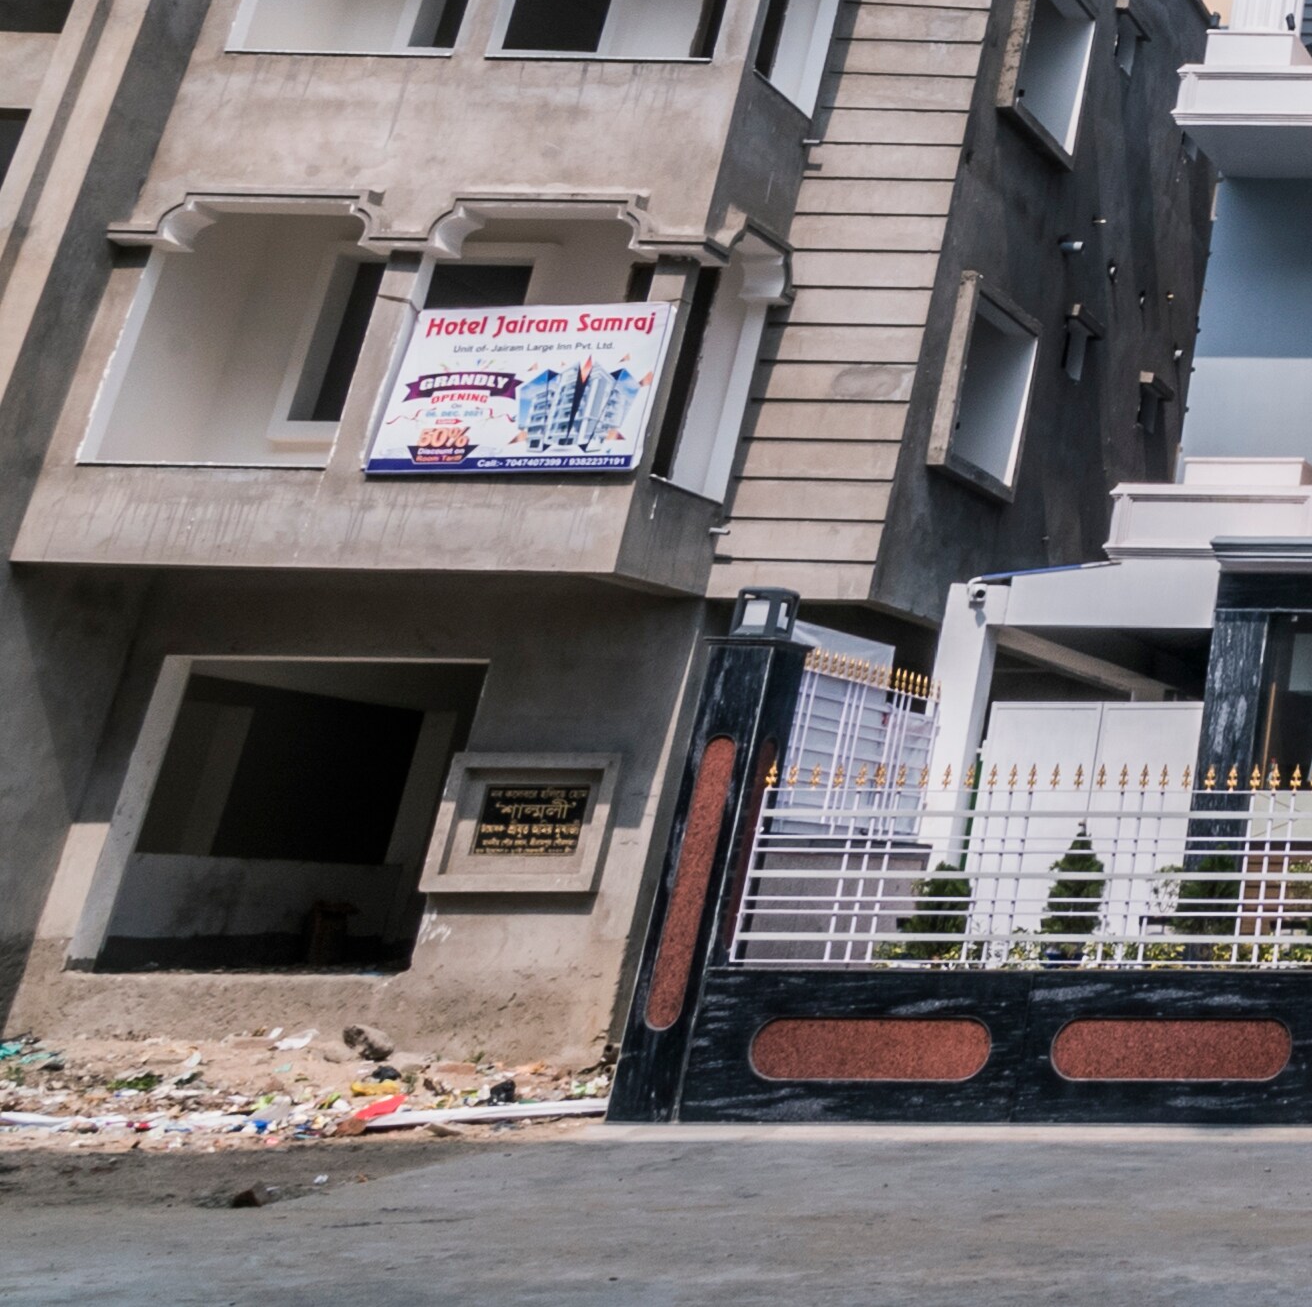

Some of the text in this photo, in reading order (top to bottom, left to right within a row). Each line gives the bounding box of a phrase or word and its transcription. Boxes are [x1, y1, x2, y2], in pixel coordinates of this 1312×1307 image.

[426, 312, 656, 338] Hotel Jairam Samraj
[453, 344, 474, 353] Unit
[491, 344, 524, 353] Jairam
[526, 343, 554, 353] Large
[556, 342, 572, 351] Inn
[419, 373, 510, 391] GRANDLY
[431, 393, 489, 404] OPENING
[417, 427, 471, 448] 50%
